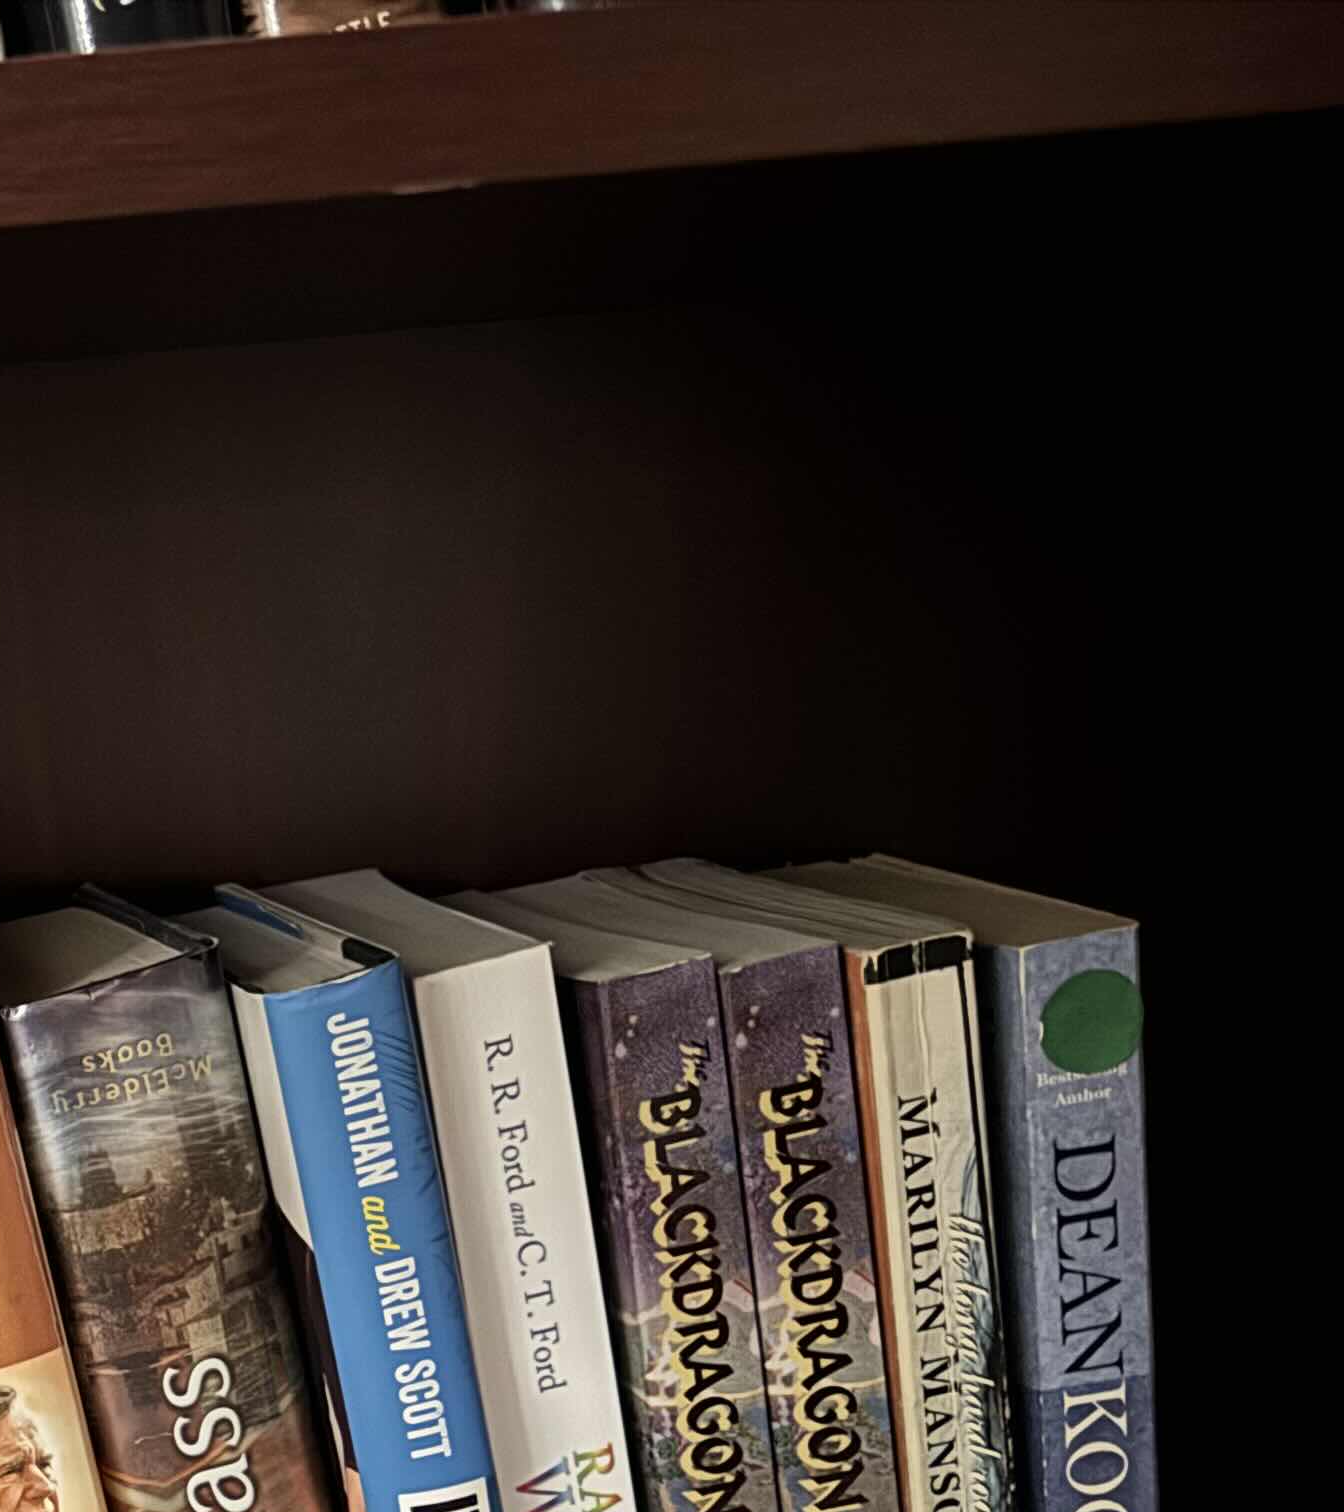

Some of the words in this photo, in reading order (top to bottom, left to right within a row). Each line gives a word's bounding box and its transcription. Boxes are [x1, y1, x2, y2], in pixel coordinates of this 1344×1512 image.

[50, 1055, 214, 1117] McElderry
[81, 1033, 175, 1074] Books
[482, 1033, 516, 1073] R.
[326, 1012, 400, 1190] JONATHAN
[489, 1075, 524, 1115] R.
[495, 1119, 535, 1194] Ford
[361, 1195, 401, 1257] and
[507, 1199, 535, 1242] and
[897, 1088, 946, 1335] MARILYN
[943, 1209, 979, 1268] the
[514, 1237, 548, 1278] C.
[1052, 1136, 1126, 1376] DEAN
[374, 1257, 419, 1352] DREW
[522, 1278, 557, 1319] T.
[950, 1273, 984, 1366] long
[528, 1321, 569, 1396] Ford
[395, 1359, 453, 1460] SCOTT
[961, 1366, 1001, 1465] hard
